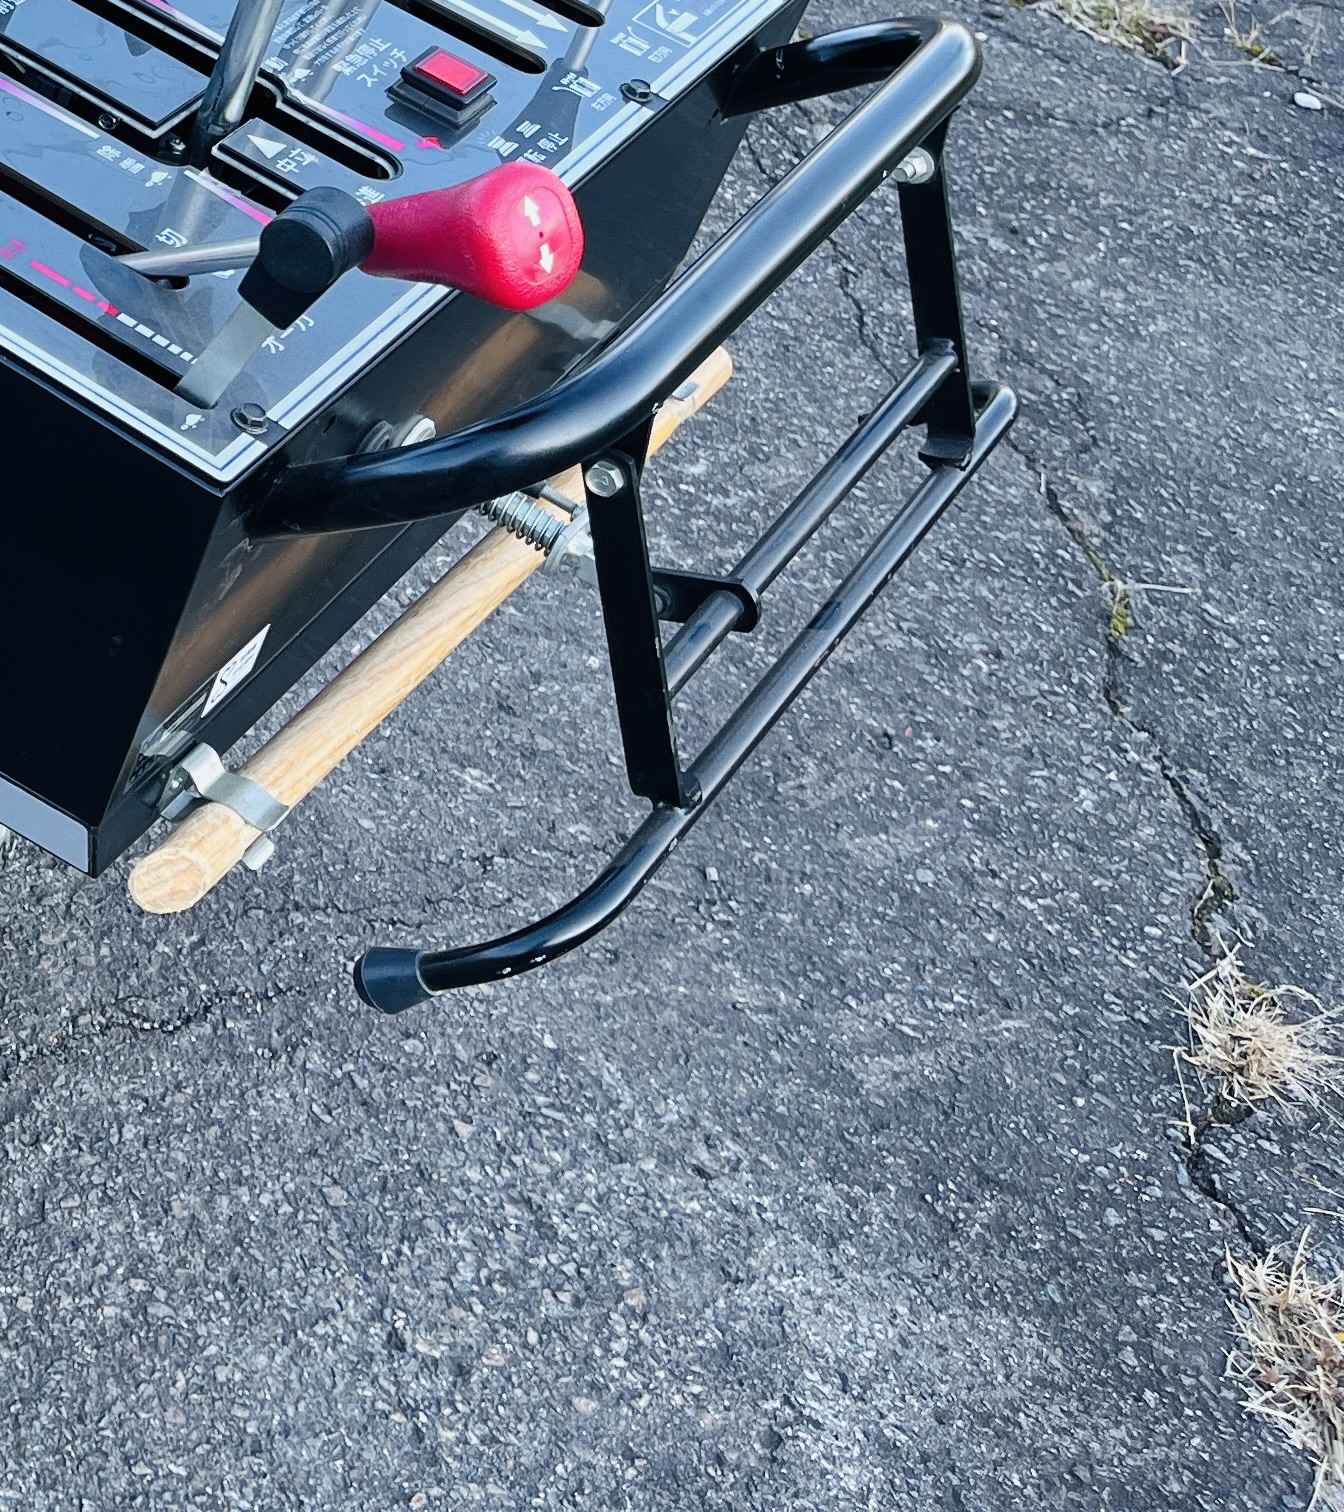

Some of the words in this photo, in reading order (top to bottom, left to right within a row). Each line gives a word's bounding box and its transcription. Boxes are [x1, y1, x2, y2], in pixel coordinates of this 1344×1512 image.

[331, 37, 392, 76] 緊急停止
[356, 47, 408, 88] スイッチ
[275, 147, 319, 174] 中立
[155, 227, 188, 248] 切
